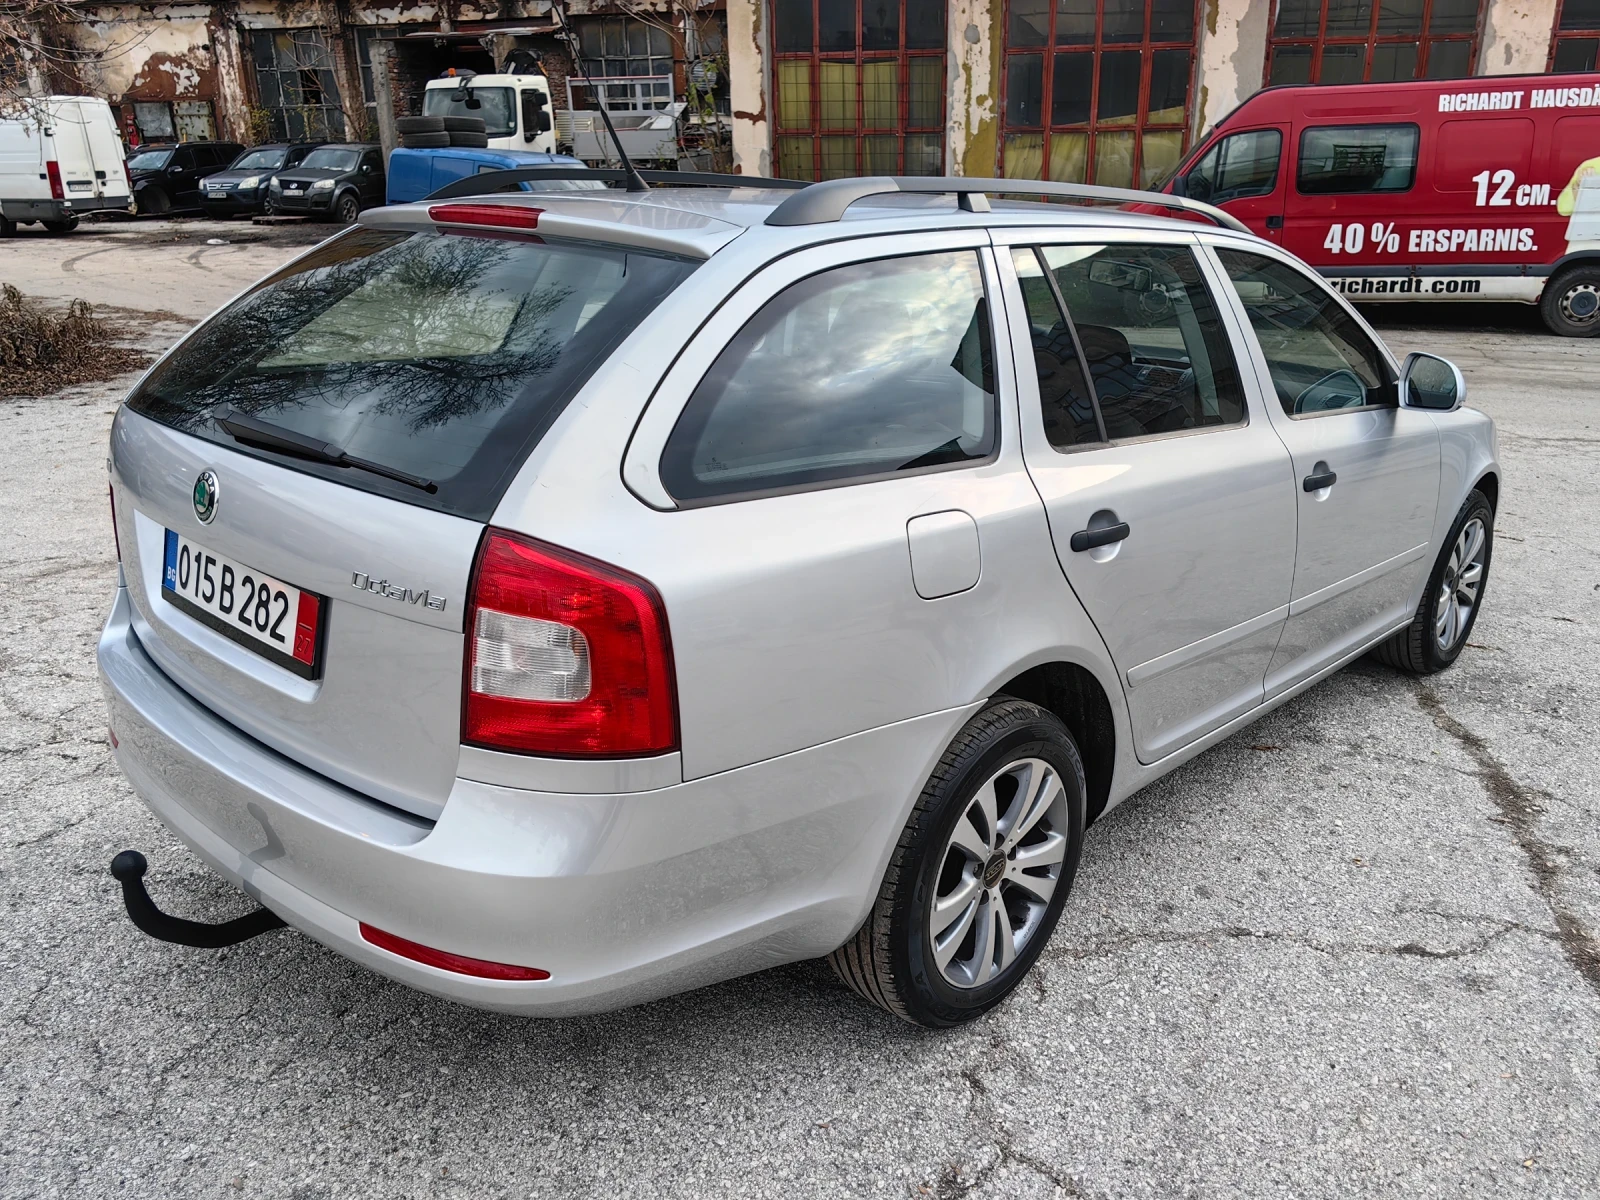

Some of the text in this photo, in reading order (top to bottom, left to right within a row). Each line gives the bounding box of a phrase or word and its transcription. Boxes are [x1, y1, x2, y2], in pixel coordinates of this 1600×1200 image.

[1438, 91, 1524, 112] RICHARDT
[1472, 169, 1515, 207] 12
[1323, 222, 1538, 254] 40 % ERSPARNIS.
[167, 566, 177, 582] BG
[351, 570, 447, 612] Octavia
